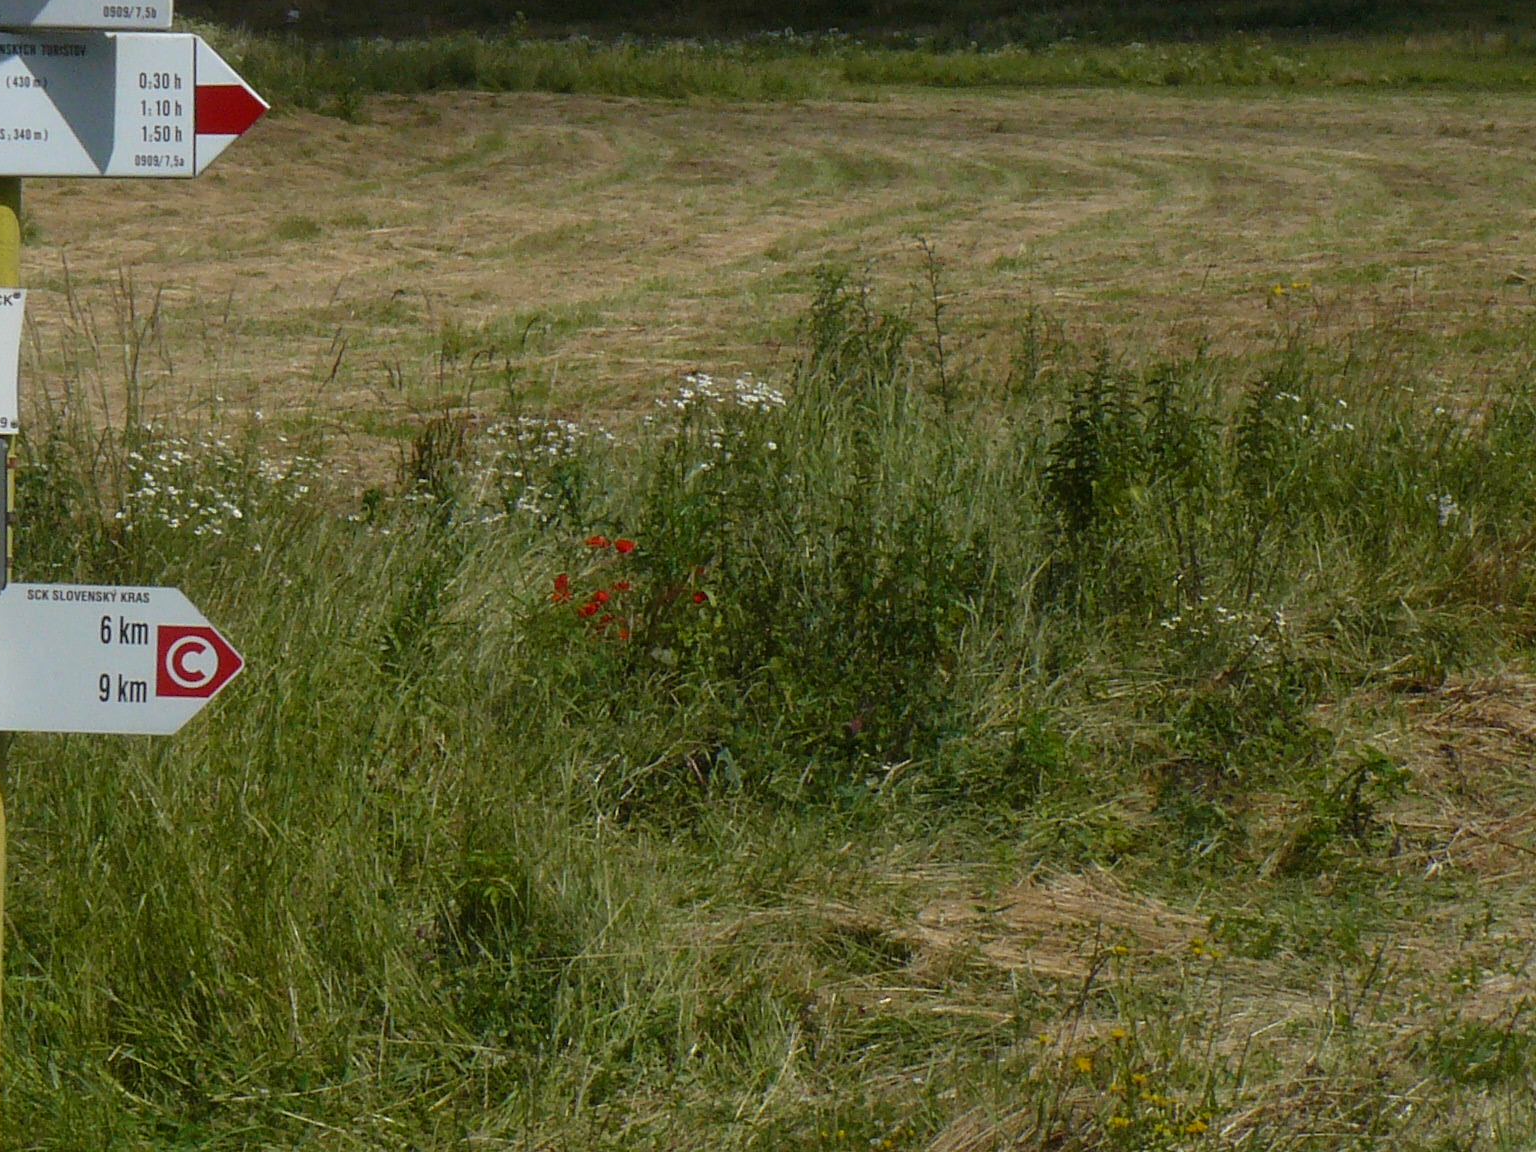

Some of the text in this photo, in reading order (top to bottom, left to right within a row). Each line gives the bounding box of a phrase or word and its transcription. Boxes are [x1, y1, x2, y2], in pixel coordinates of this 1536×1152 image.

[174, 73, 182, 89] h
[175, 100, 183, 117] h
[175, 126, 183, 143] h
[27, 589, 151, 604] SCK SLOVENSKÝ KRAS
[100, 615, 149, 646] 6 km
[99, 673, 148, 704] 9 km
